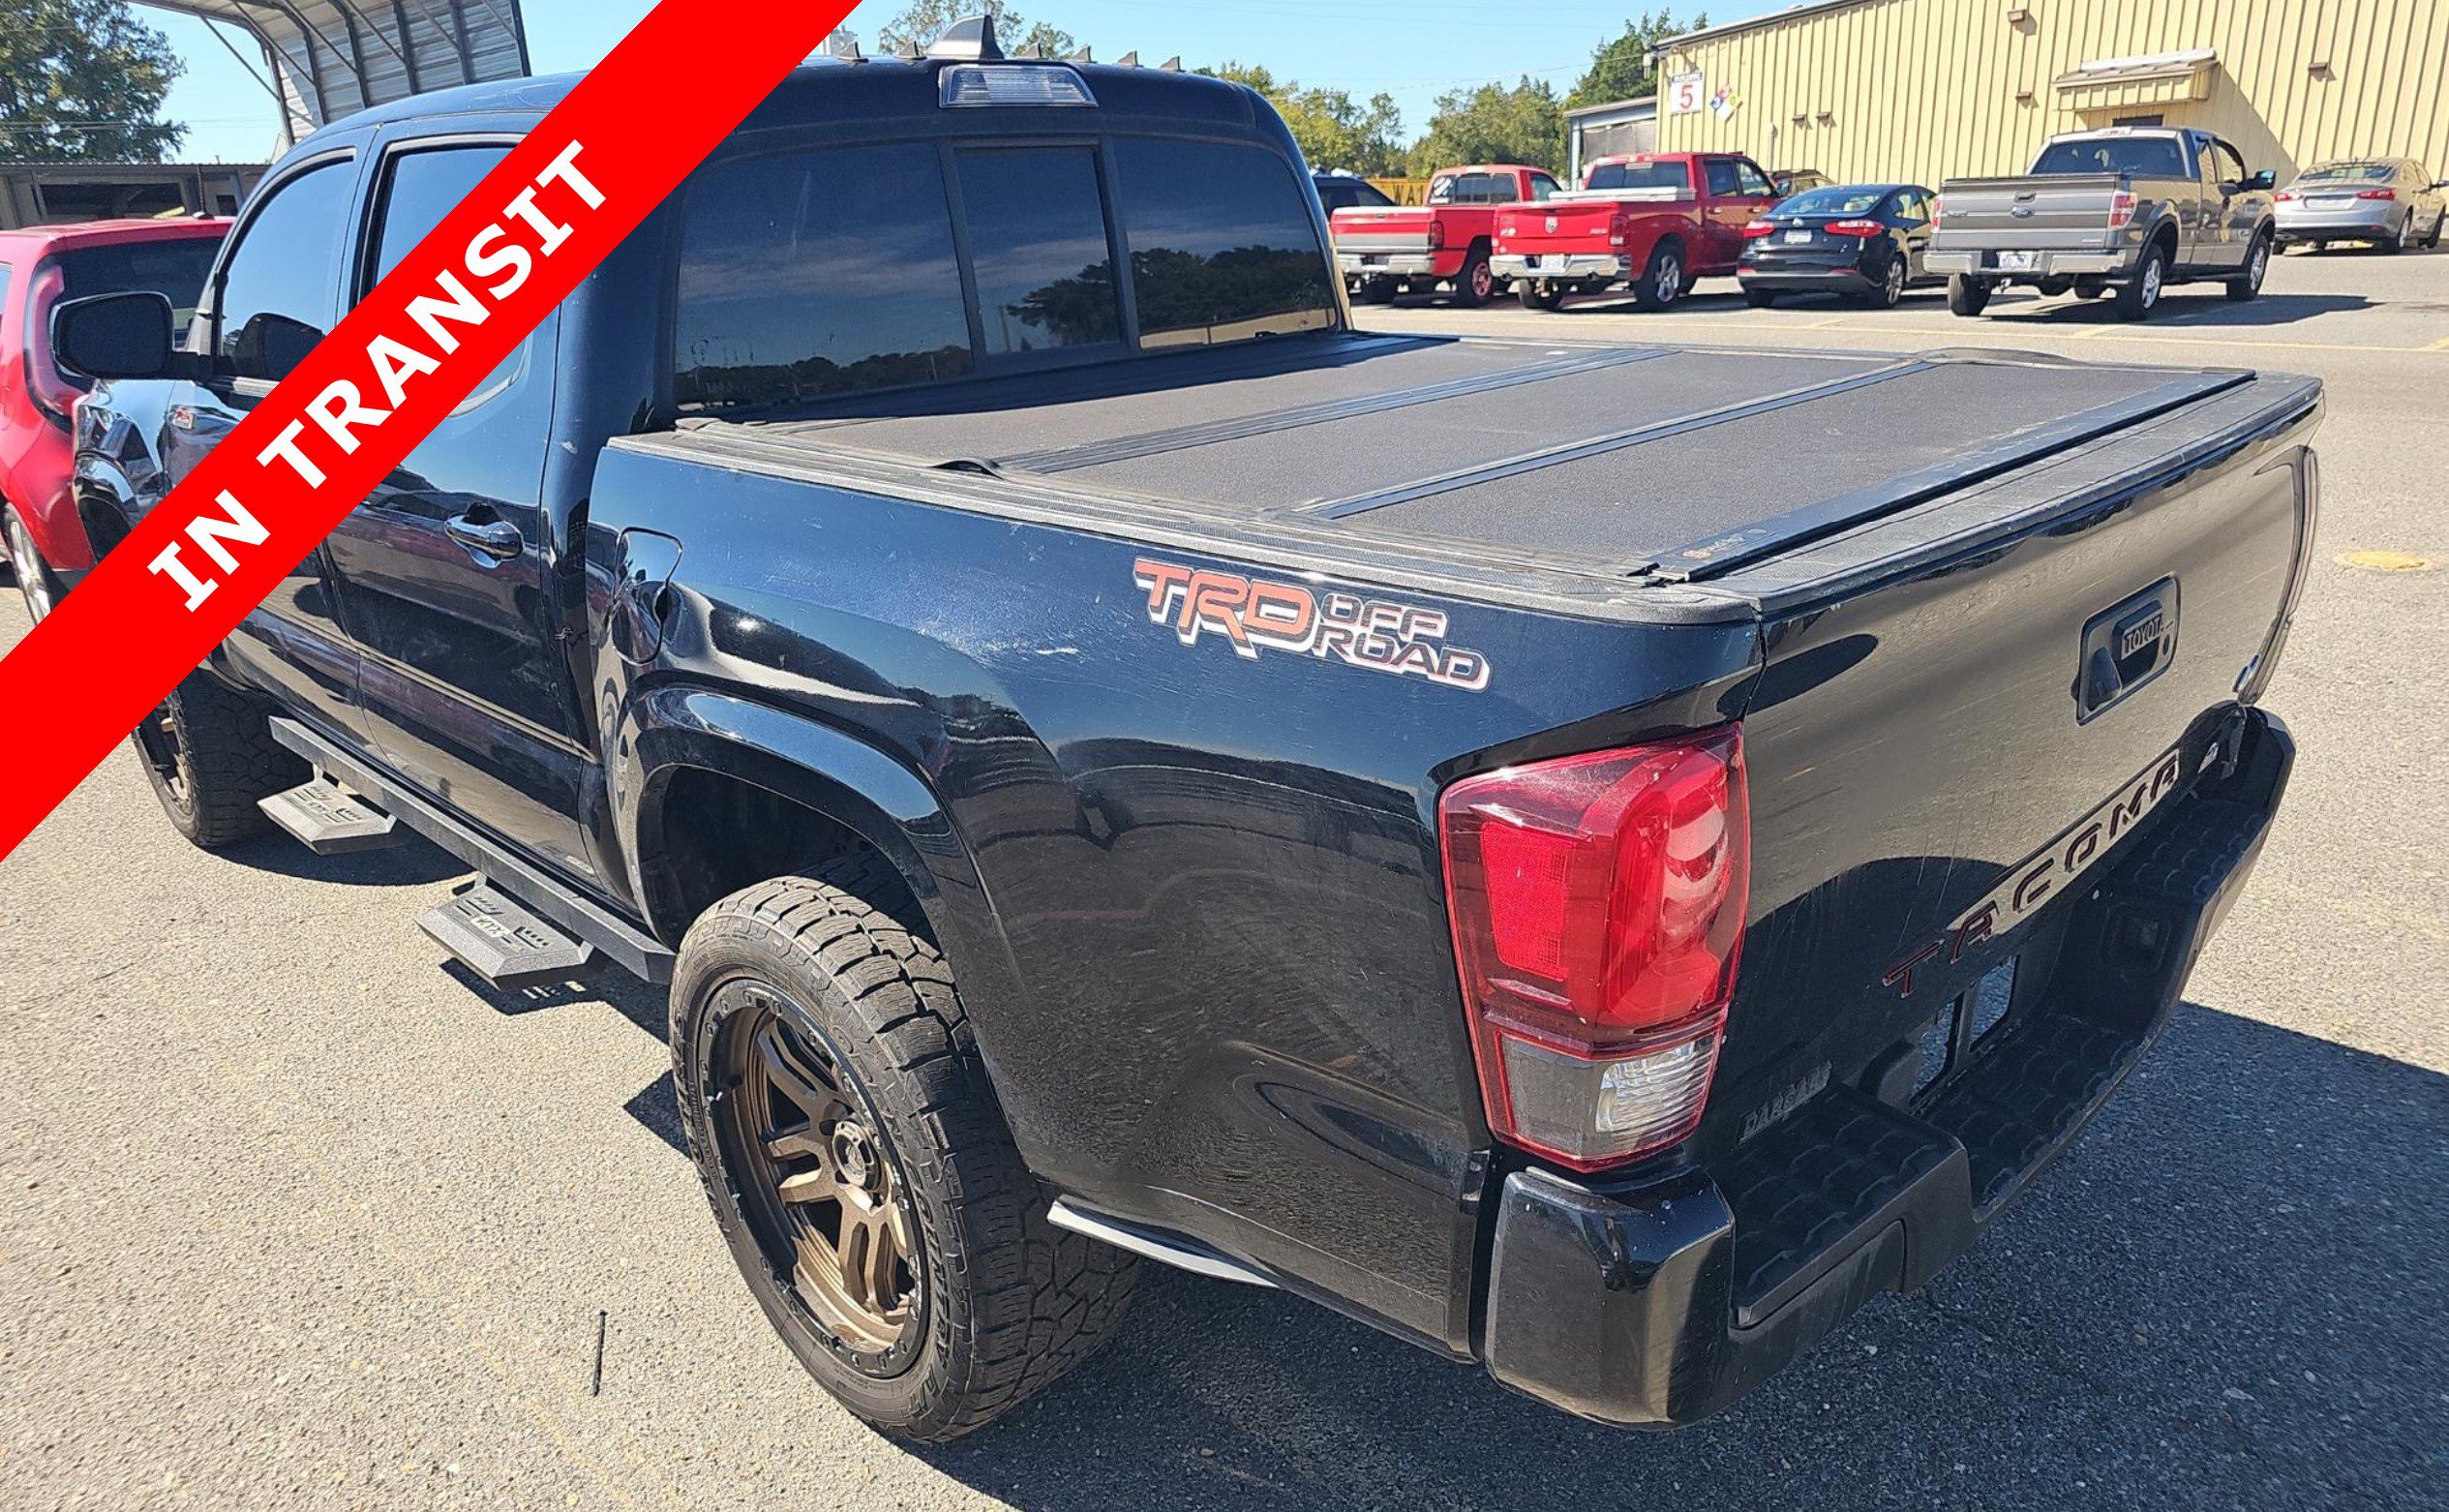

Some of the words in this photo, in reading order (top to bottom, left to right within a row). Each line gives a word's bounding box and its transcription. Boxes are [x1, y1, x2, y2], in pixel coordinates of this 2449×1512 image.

[1680, 83, 1693, 109] 5
[1134, 558, 1320, 660] TRD
[1320, 593, 1449, 642] OFF
[2124, 612, 2164, 654] TOYOT
[1311, 624, 1492, 692] ROAD
[1881, 747, 2182, 1000] TACOMA
